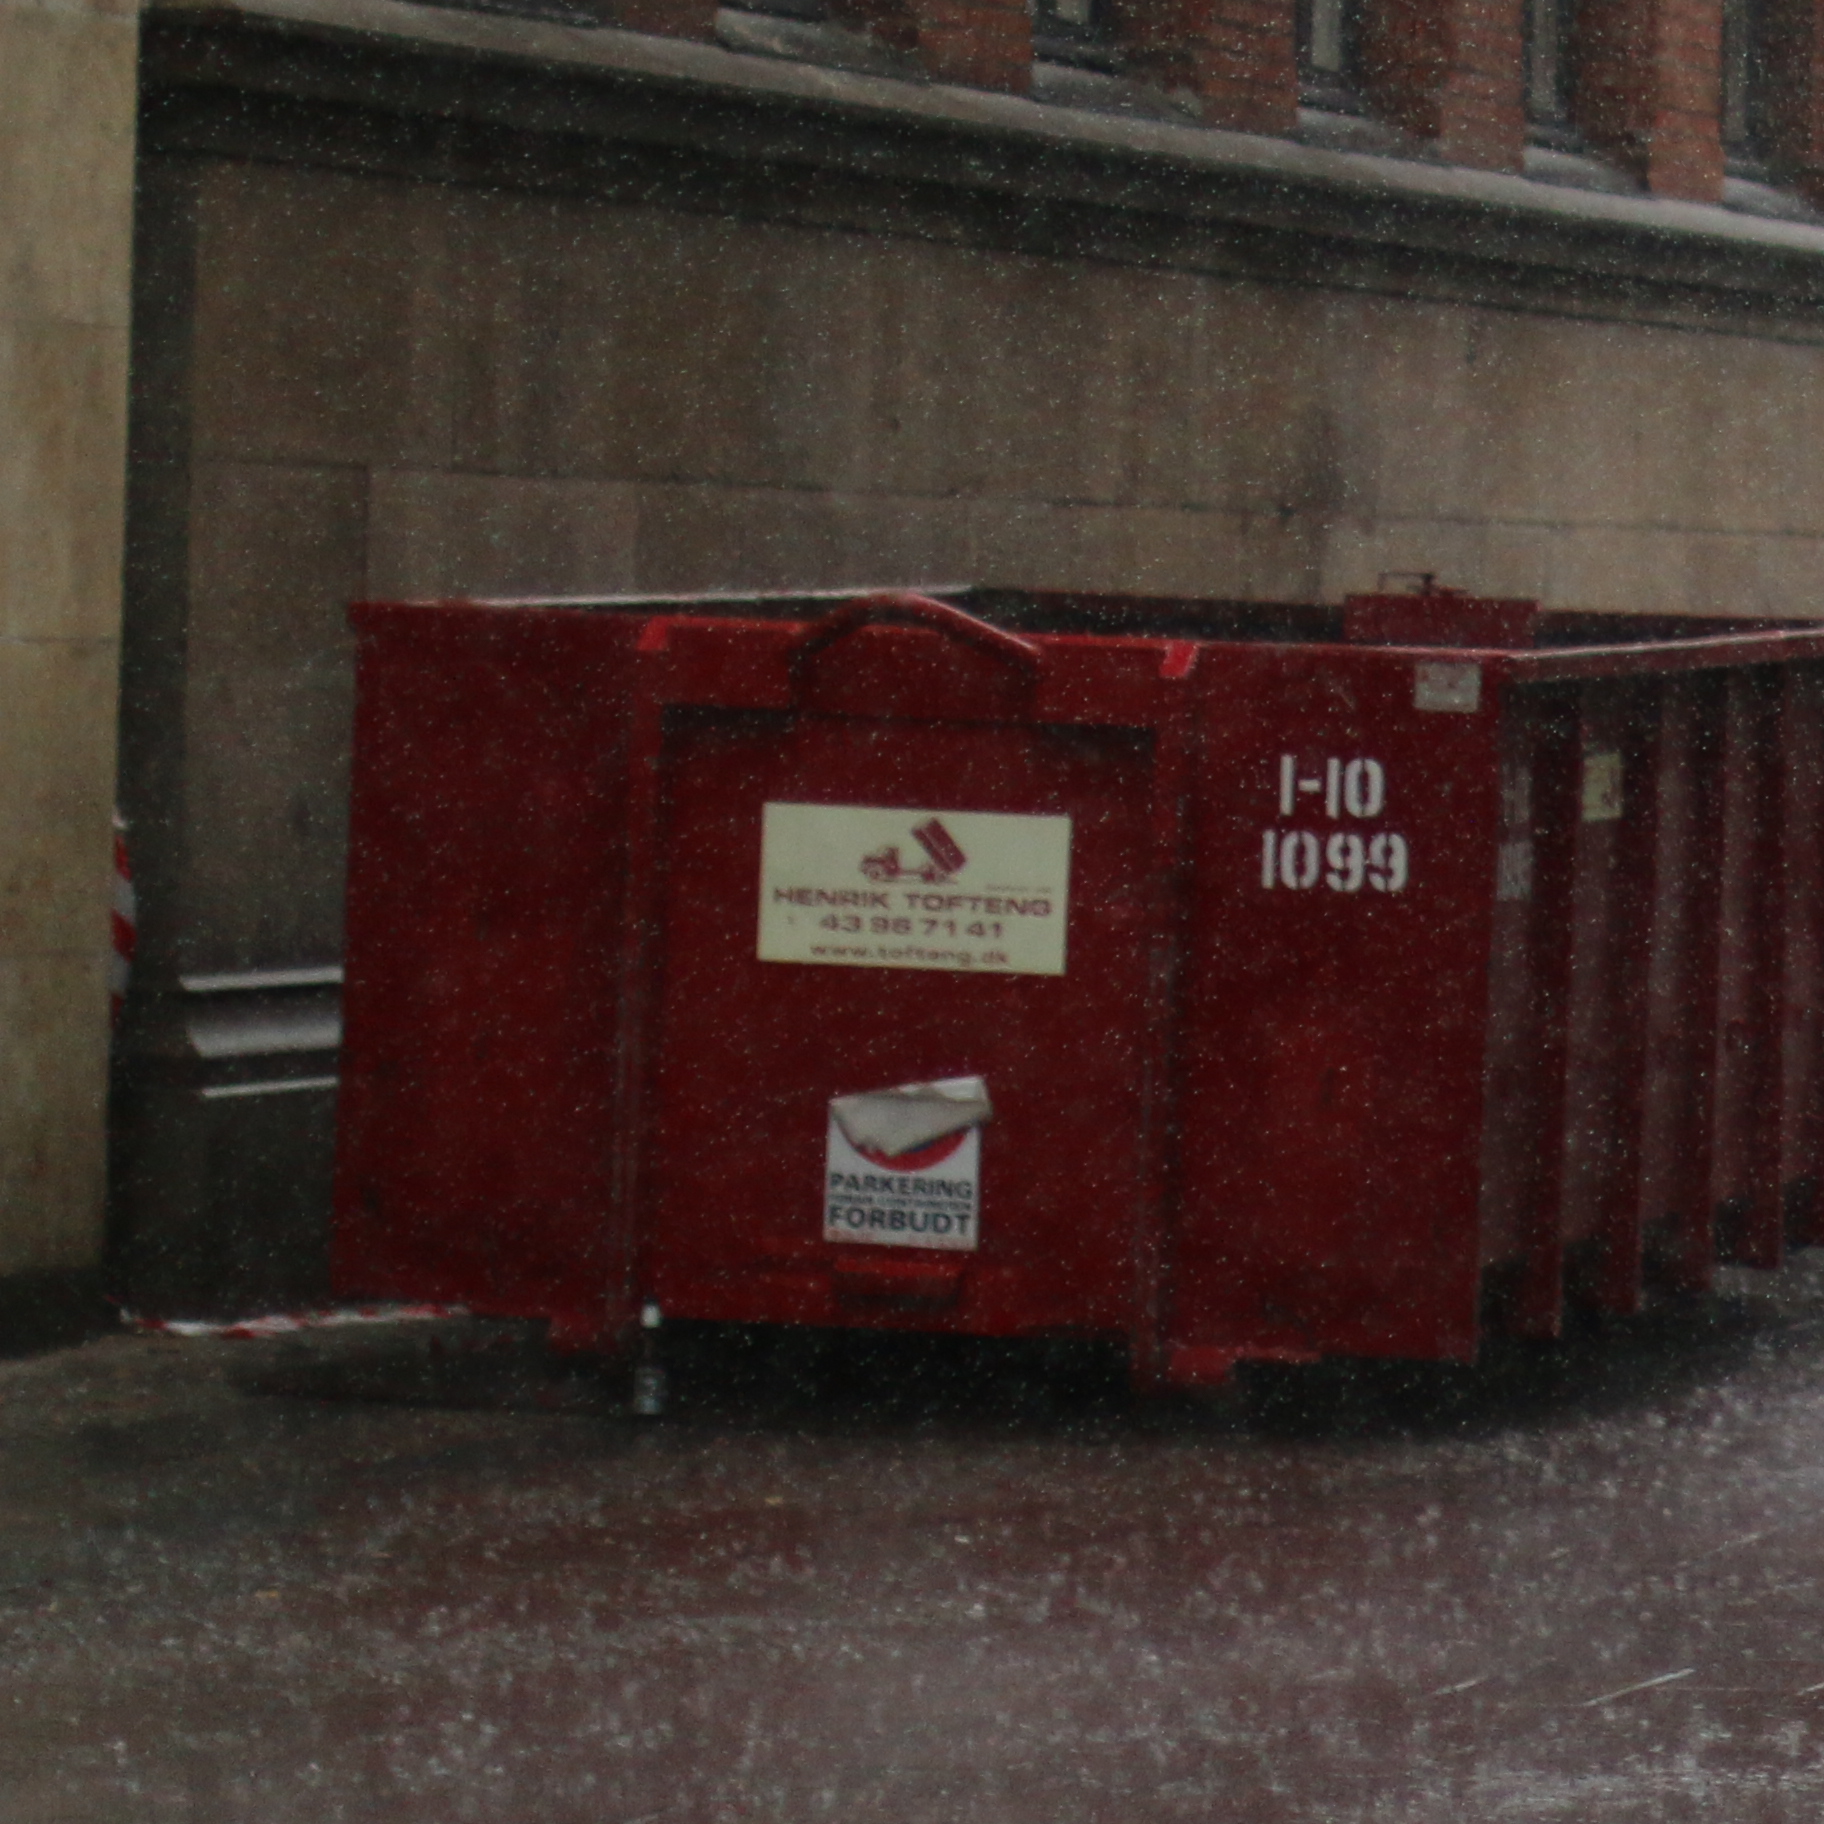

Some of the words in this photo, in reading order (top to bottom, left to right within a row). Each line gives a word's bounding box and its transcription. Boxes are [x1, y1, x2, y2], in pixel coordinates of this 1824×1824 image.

[1261, 828, 1409, 892] 1099
[773, 886, 890, 910] HENRIK
[903, 891, 1052, 917] TOFTENG
[810, 942, 1008, 965] www.tofteng.dk
[829, 1173, 973, 1198] PARKERING
[829, 1205, 970, 1235] FORBUDT
